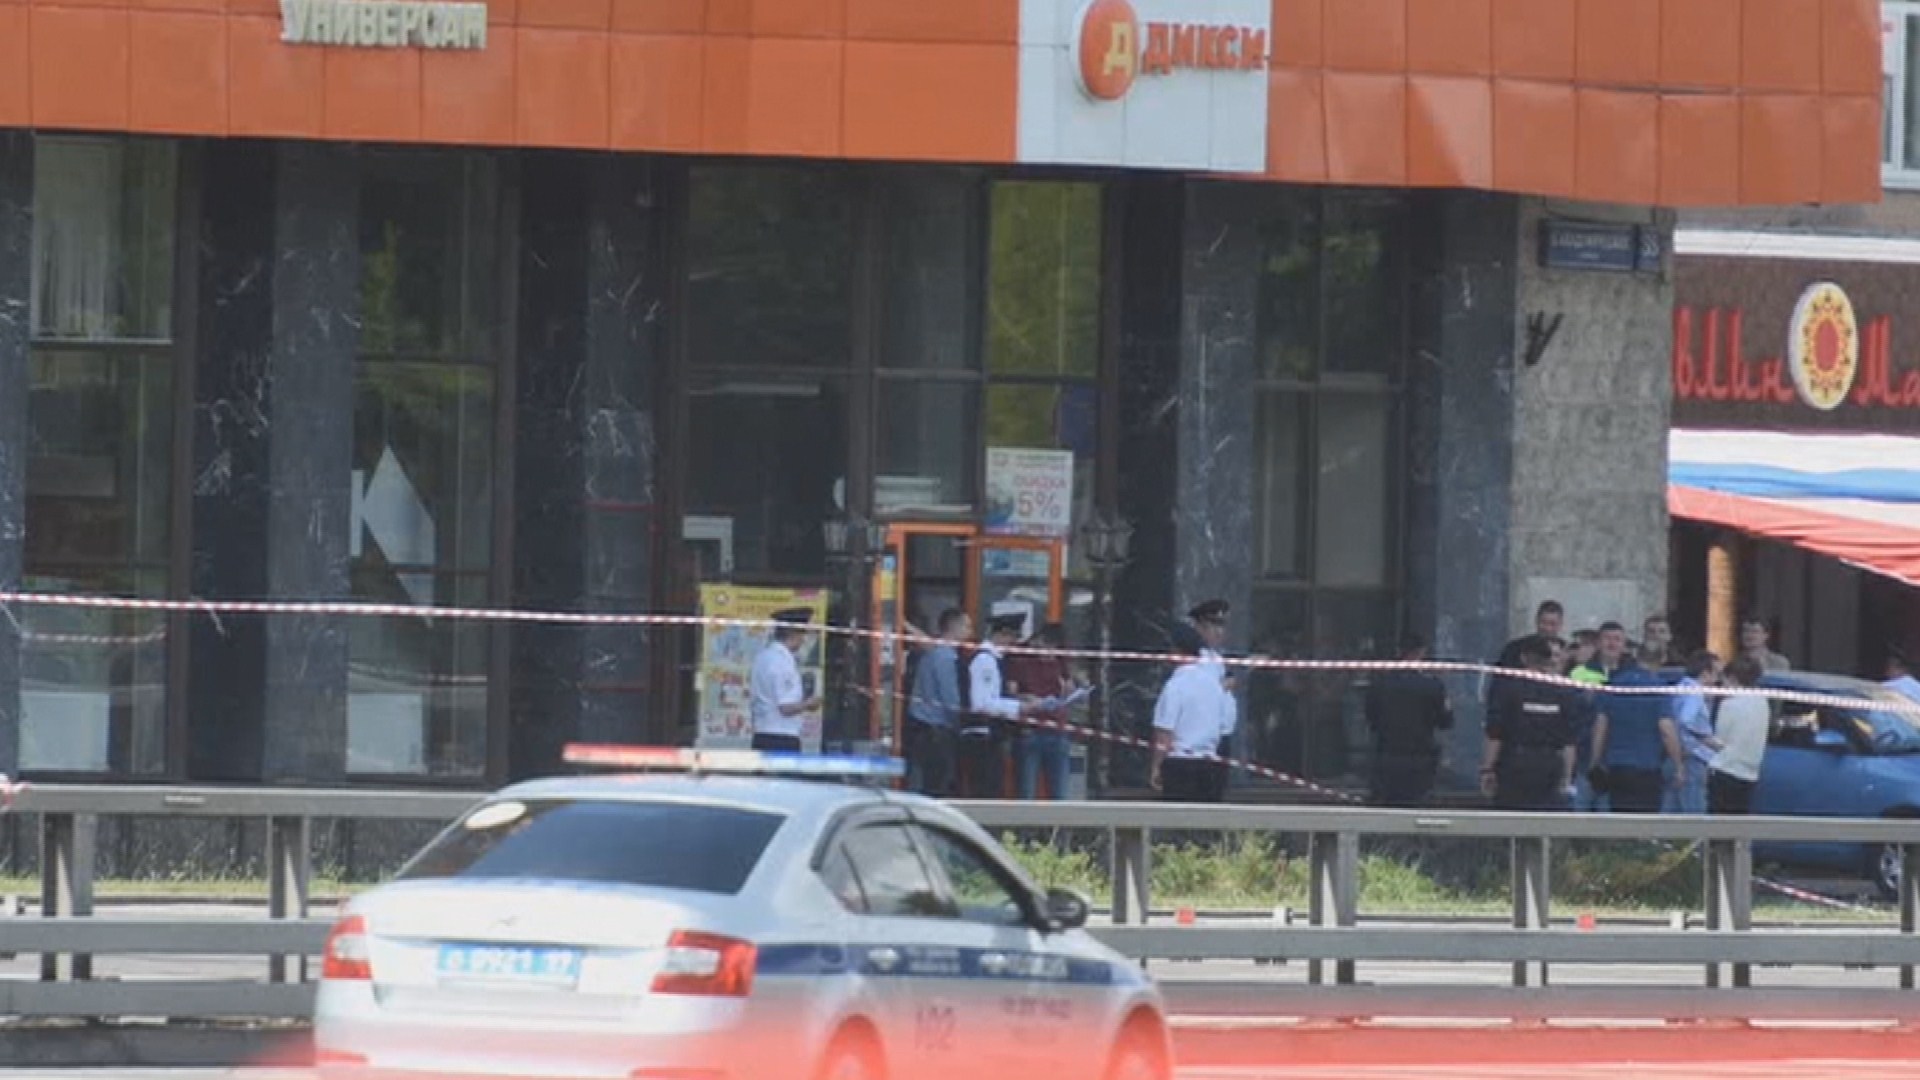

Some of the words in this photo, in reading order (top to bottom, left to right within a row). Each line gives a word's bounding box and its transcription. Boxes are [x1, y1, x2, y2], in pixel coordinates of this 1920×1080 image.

[281, 0, 487, 49] УНИВЕРСАМ
[1104, 21, 1135, 77] Д
[1142, 22, 1266, 75] ДИКСИ
[1018, 490, 1062, 520] 5%
